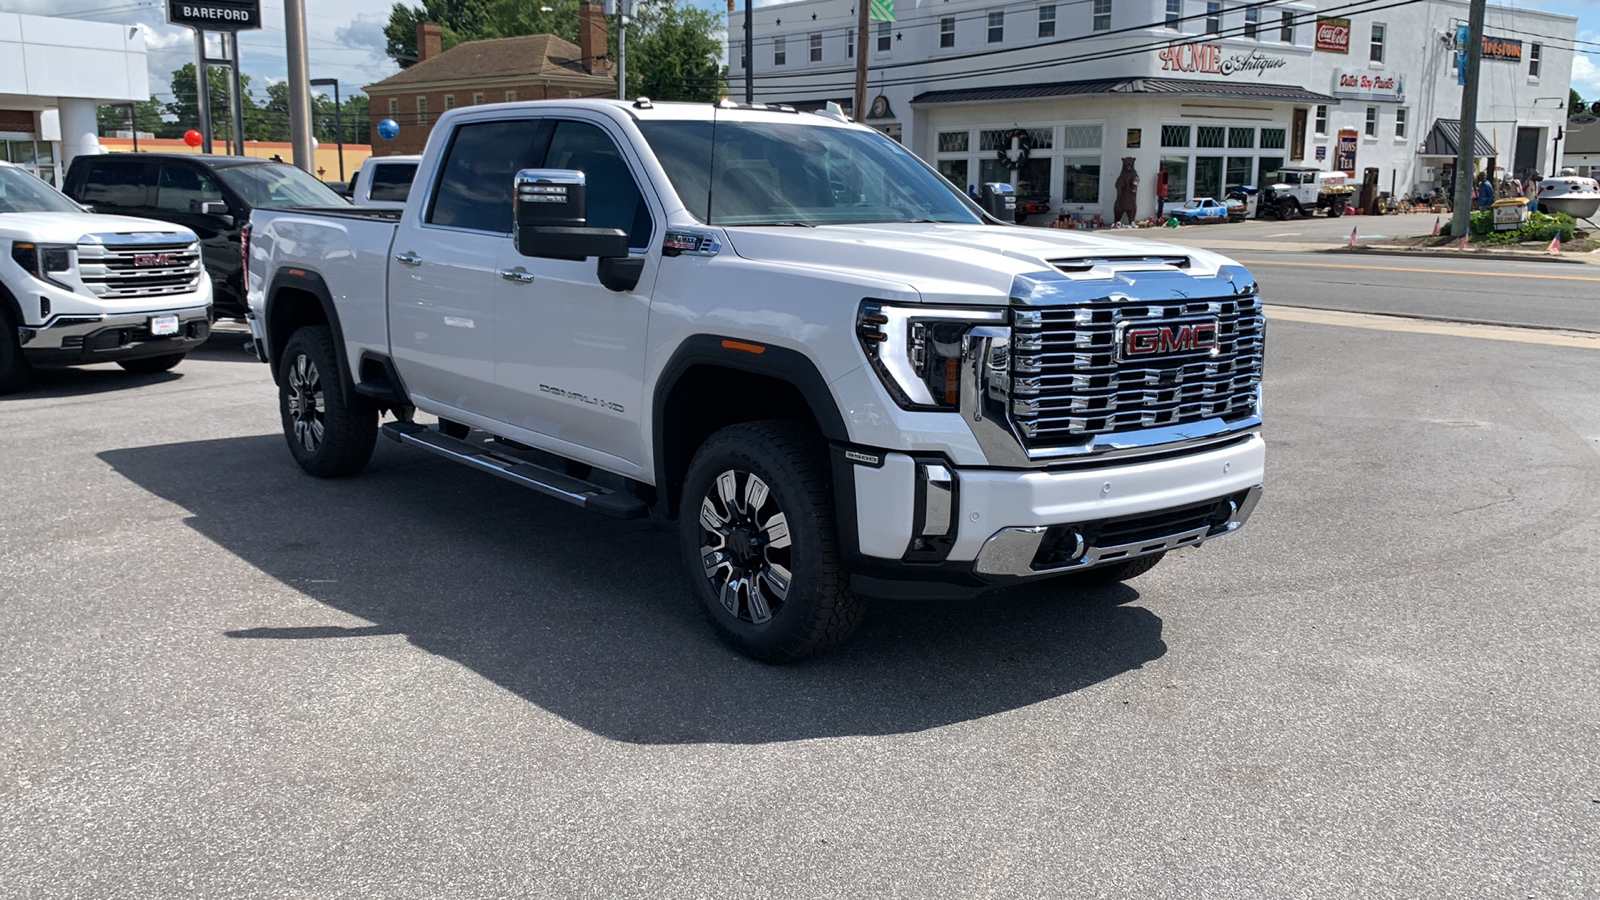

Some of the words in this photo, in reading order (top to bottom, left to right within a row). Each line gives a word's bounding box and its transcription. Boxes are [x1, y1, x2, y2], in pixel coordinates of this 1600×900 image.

[183, 6, 249, 21] BAREFORD
[1159, 40, 1222, 74] ACME
[1340, 74, 1358, 87] Dutch
[1360, 75, 1373, 91] Boy
[1373, 76, 1394, 89] Paints
[1340, 157, 1353, 169] TEA
[135, 254, 178, 267] GMC
[1126, 325, 1216, 355] GMC
[540, 384, 598, 405] DENALI
[600, 399, 625, 413] HD
